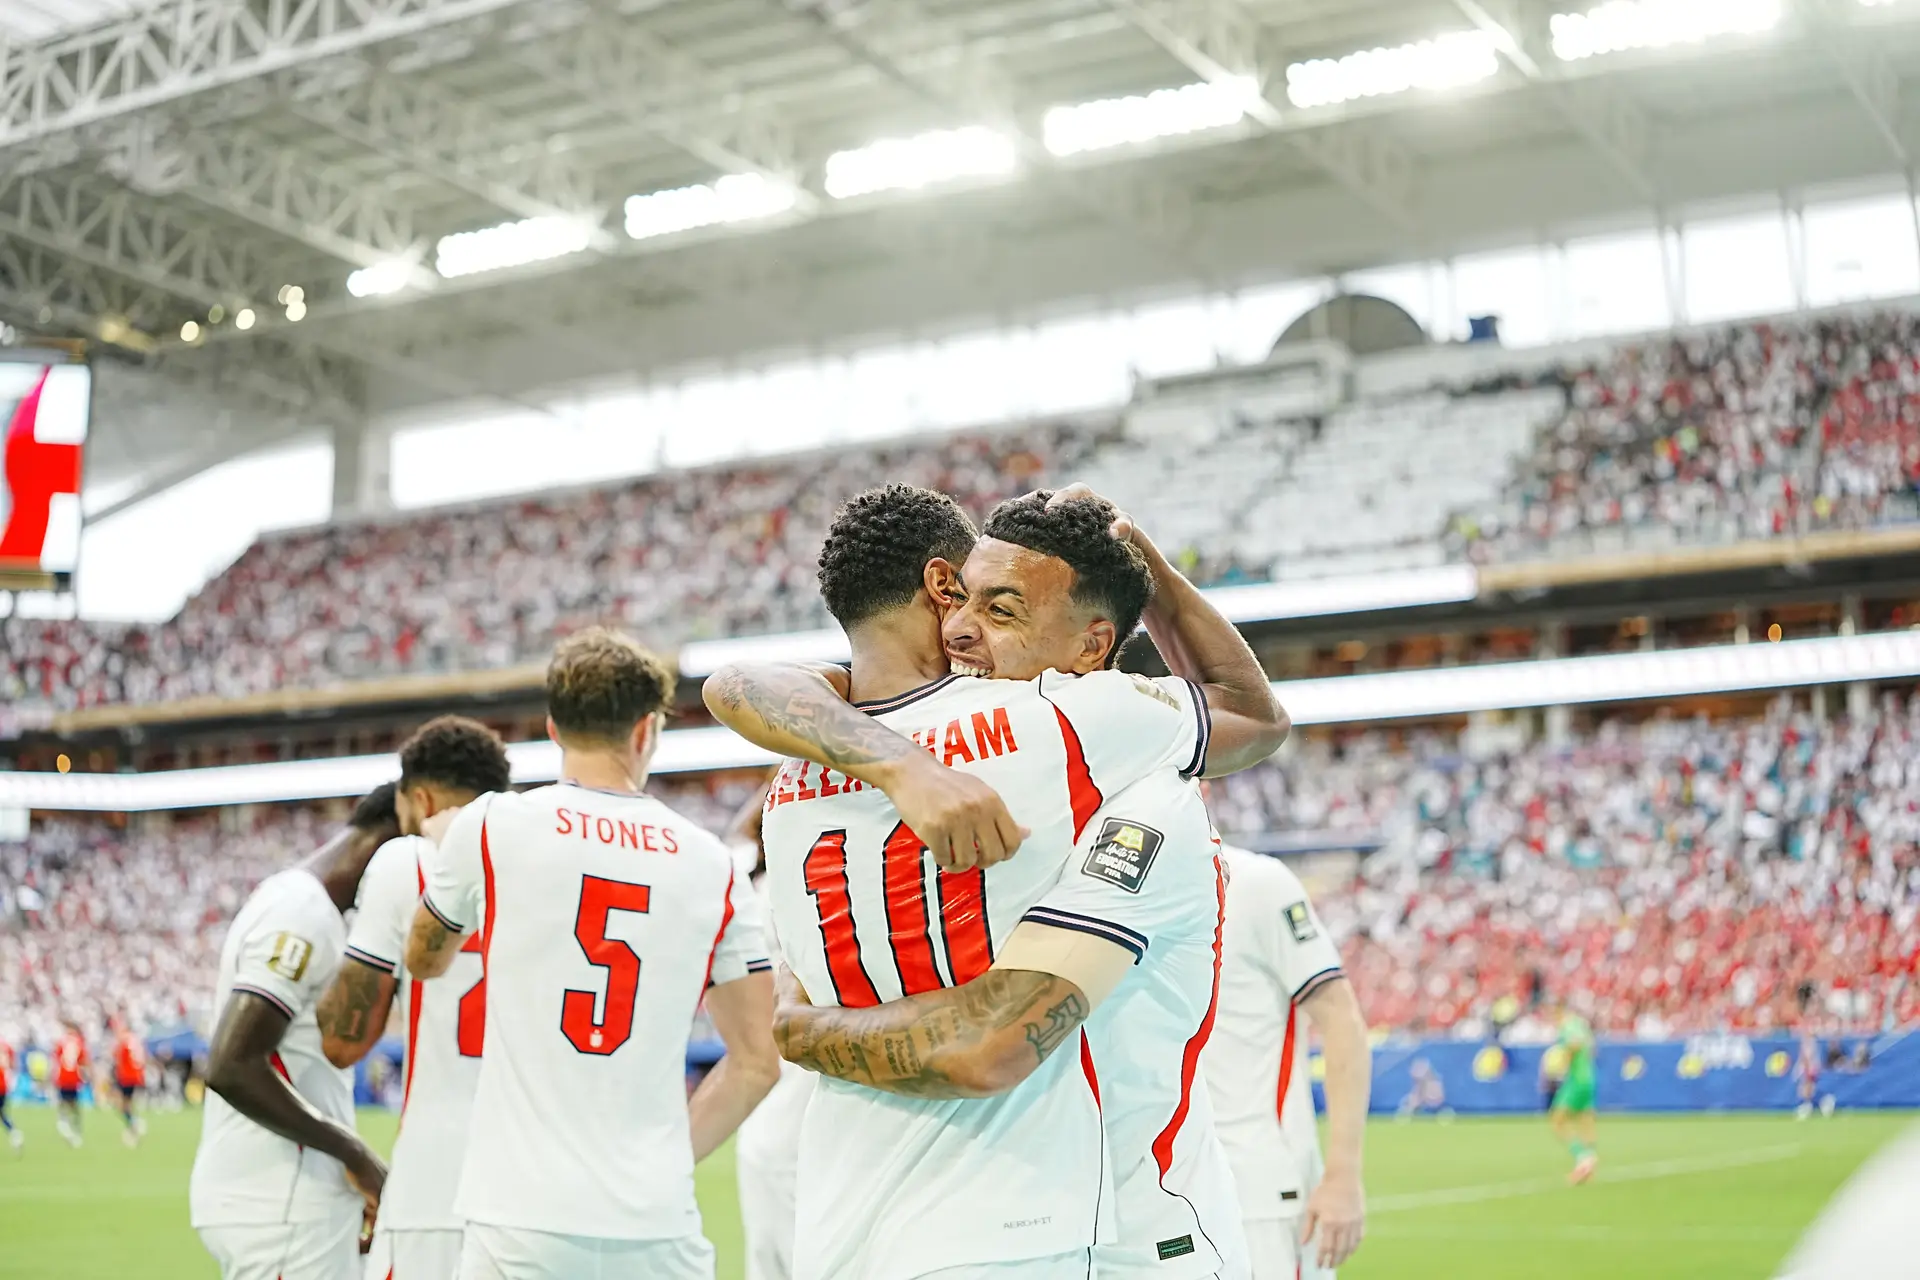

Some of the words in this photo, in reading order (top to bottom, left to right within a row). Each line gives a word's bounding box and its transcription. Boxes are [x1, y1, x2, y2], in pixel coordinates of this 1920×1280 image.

[555, 807, 679, 855] STONES
[1095, 853, 1140, 878] EDUCATION
[1104, 867, 1122, 879] FIFA
[803, 818, 996, 1007] 10
[561, 874, 651, 1055] 5
